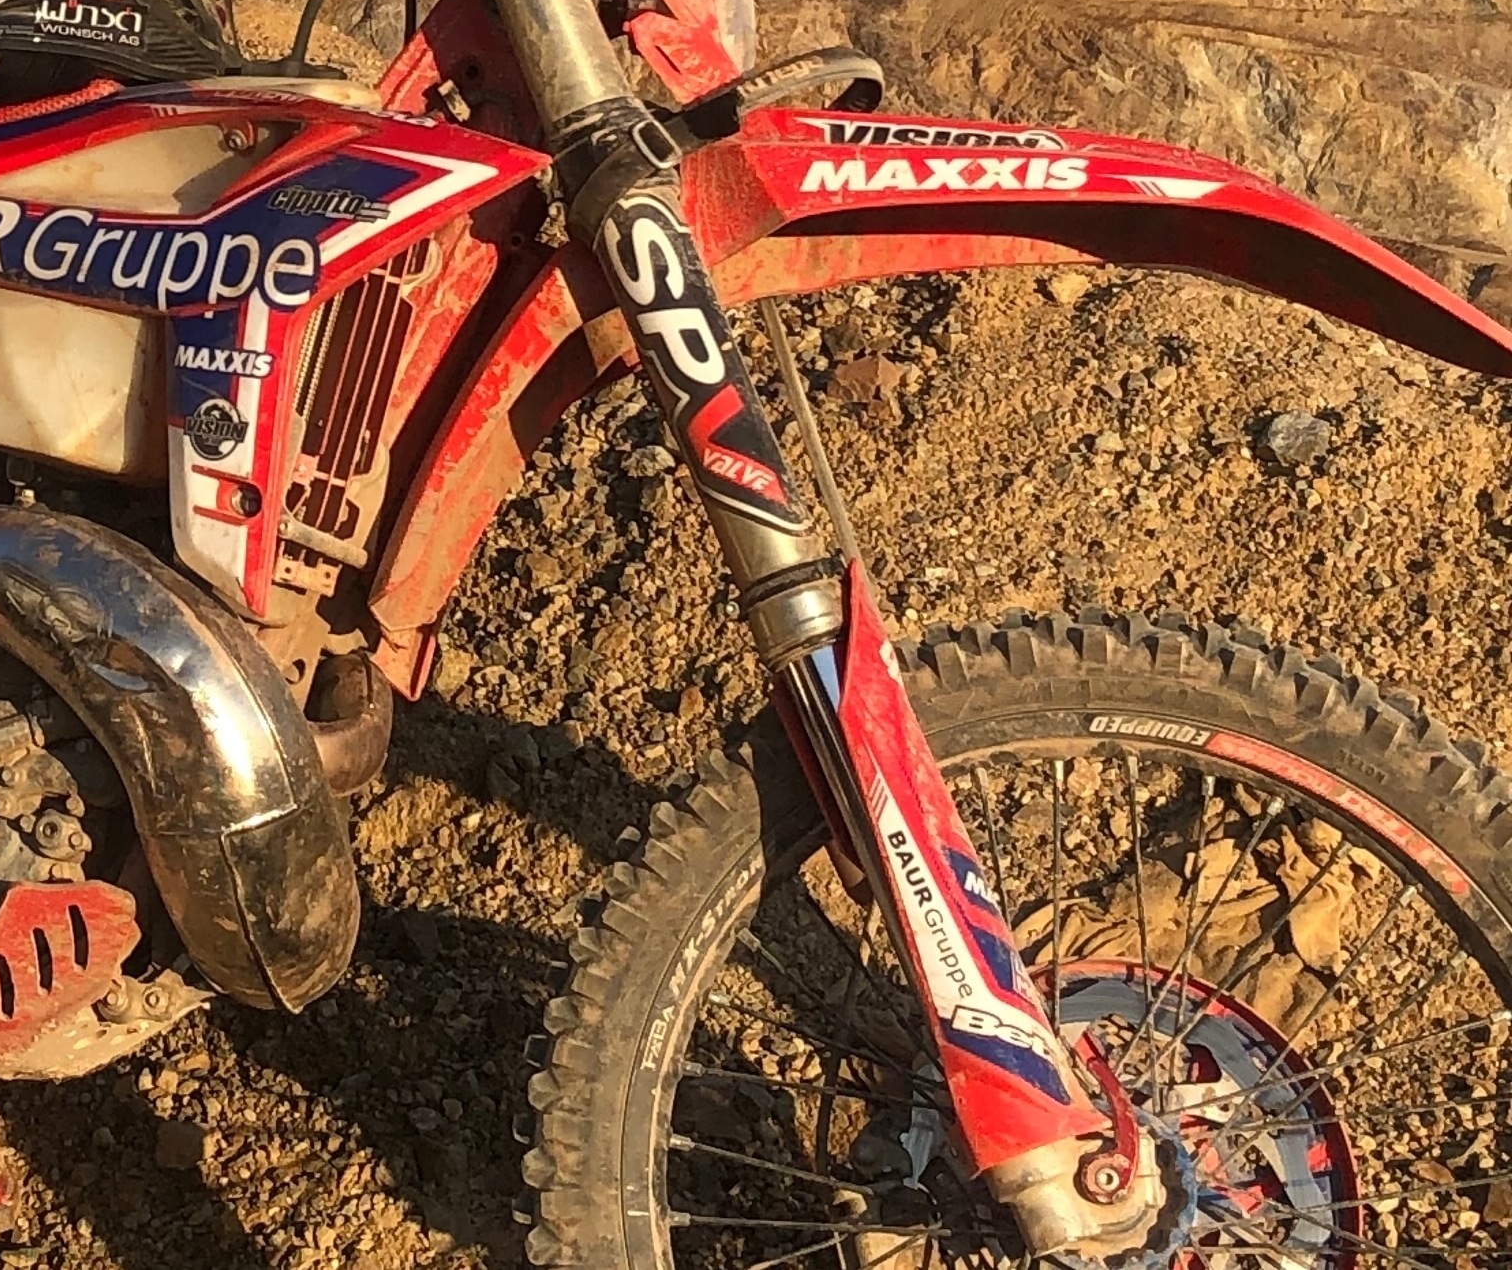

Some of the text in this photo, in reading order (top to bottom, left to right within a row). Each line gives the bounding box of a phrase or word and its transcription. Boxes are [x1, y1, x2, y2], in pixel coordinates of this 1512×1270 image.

[799, 158, 1091, 192] MAXXIS
[22, 206, 319, 320] Gruppe
[175, 343, 273, 378] MAXXIS
[1089, 716, 1211, 746] EQUIPPED
[887, 830, 974, 999] BAUR Gruppe
